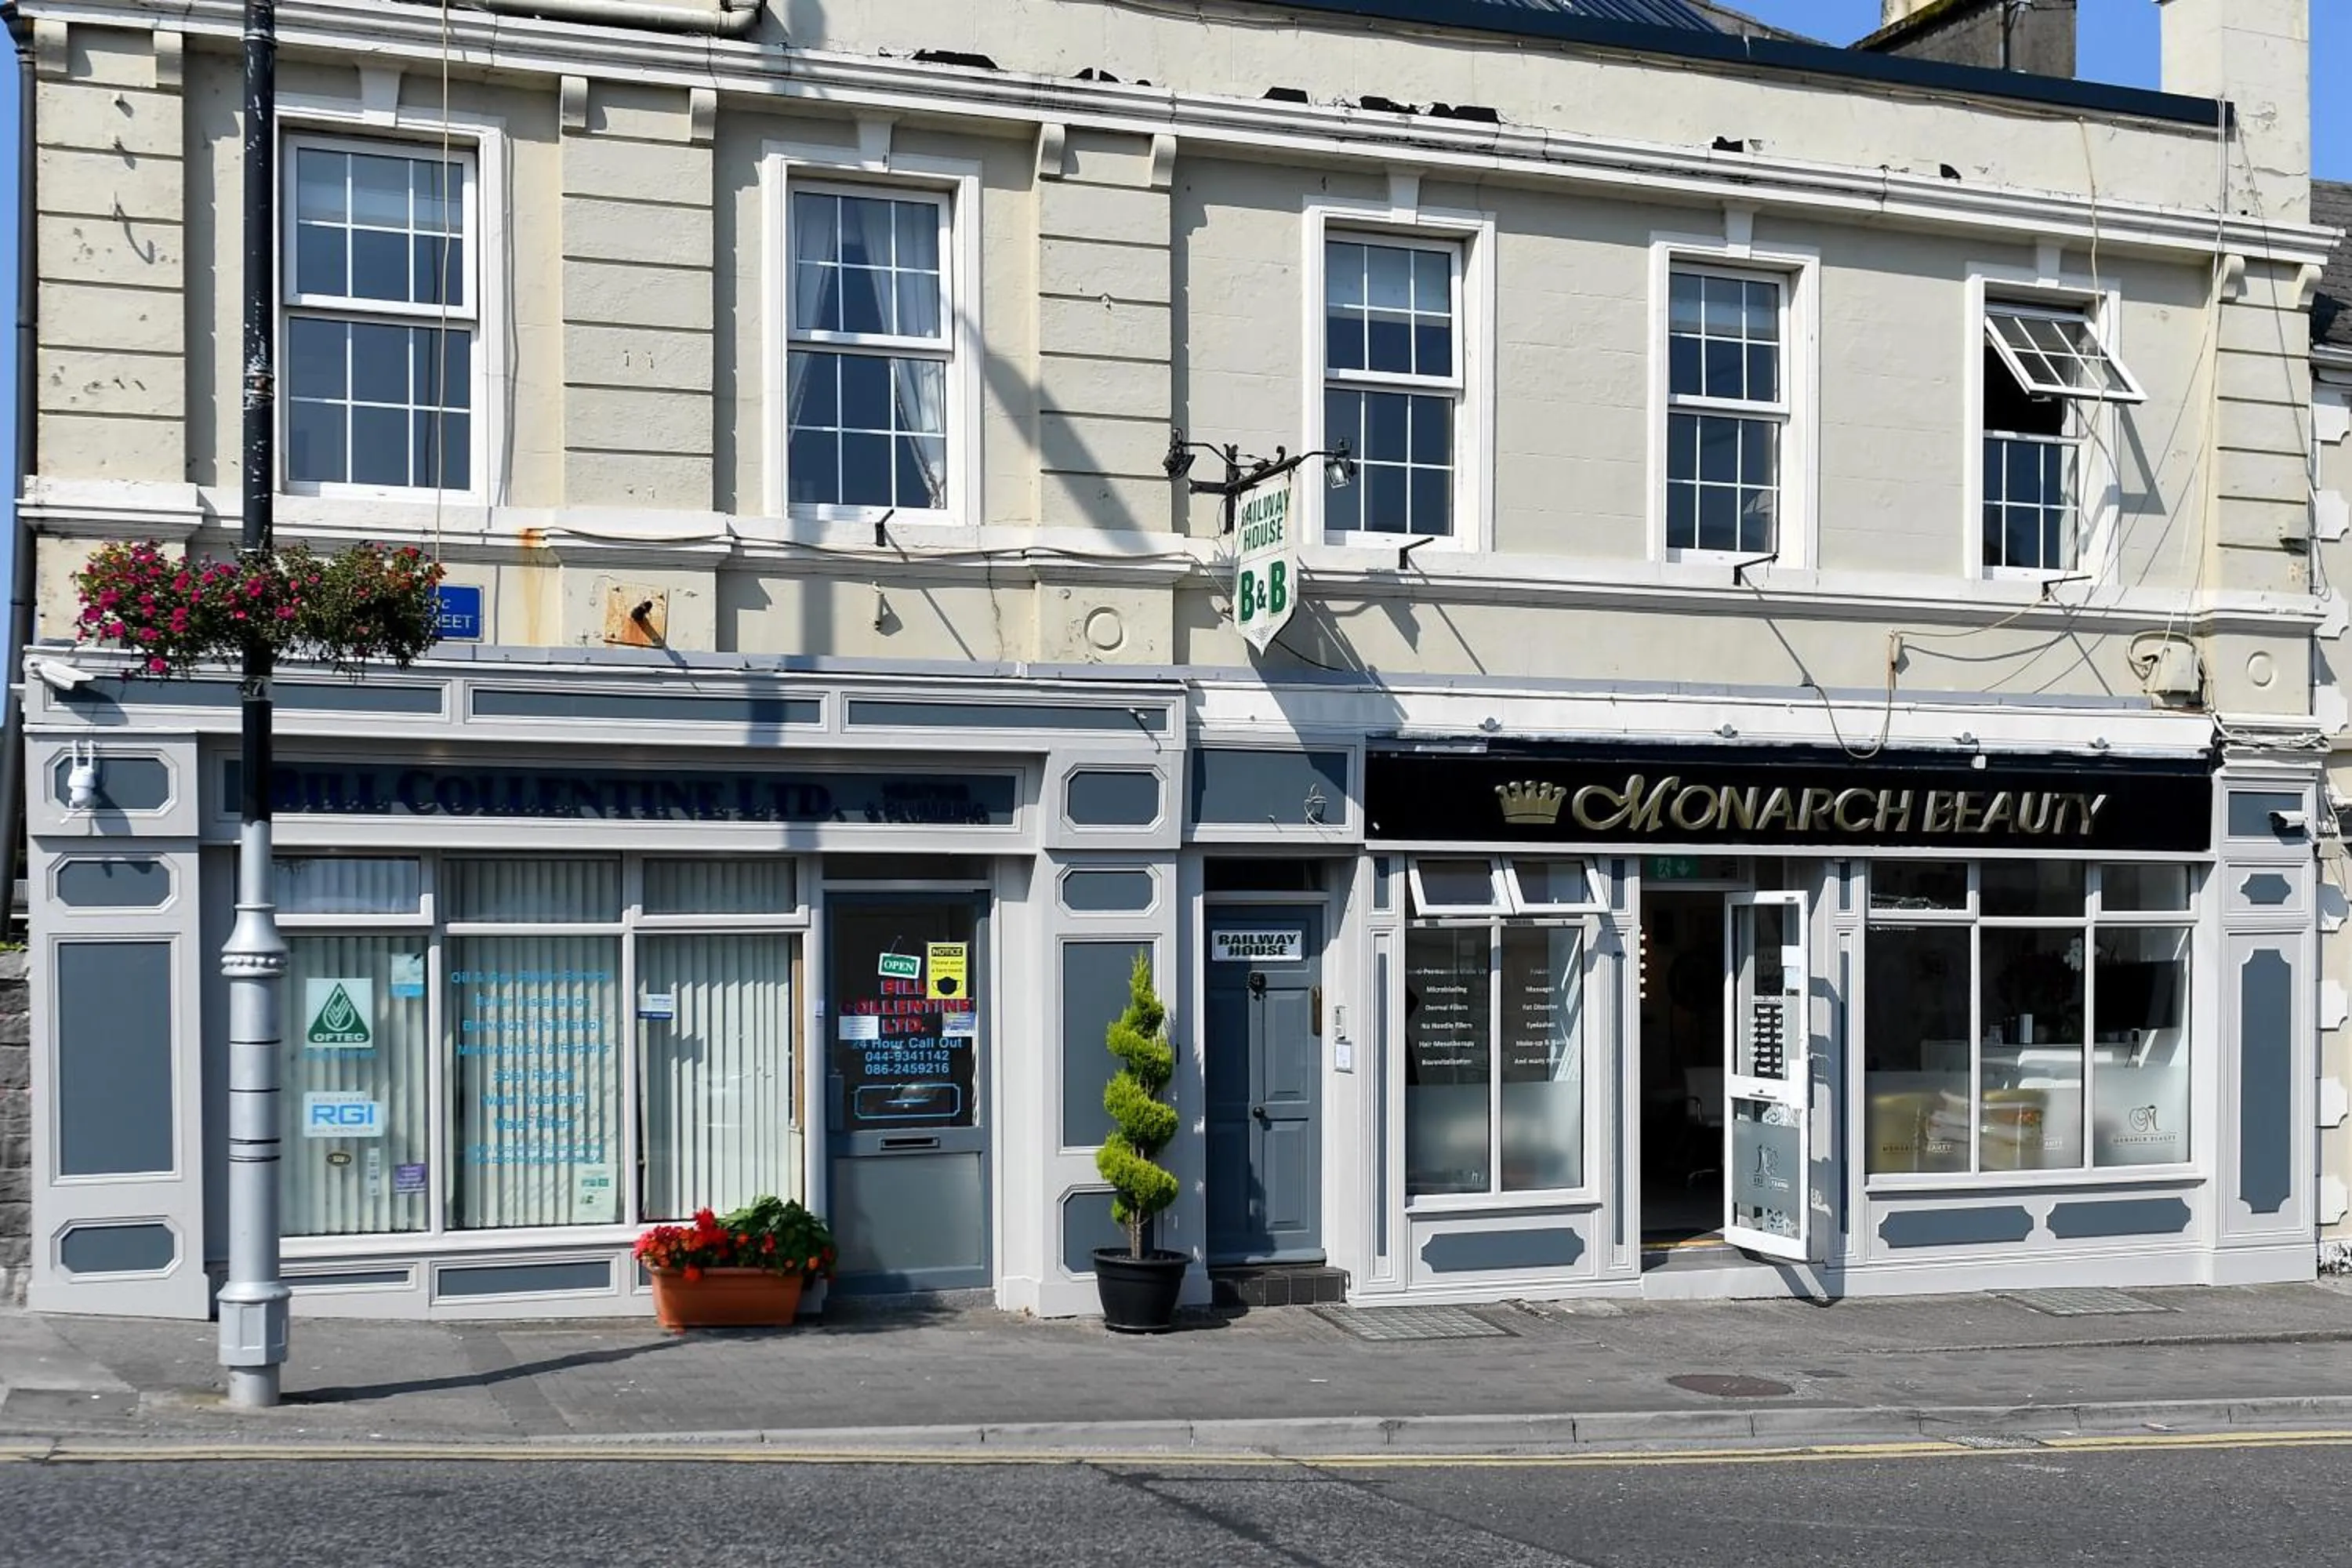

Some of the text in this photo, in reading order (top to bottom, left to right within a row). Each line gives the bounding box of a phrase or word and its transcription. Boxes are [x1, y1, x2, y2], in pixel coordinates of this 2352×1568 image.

[1243, 517, 1283, 551] HOUSE
[432, 614, 474, 629] REET
[1572, 775, 2107, 835] MONARCH BEAUTY
[1218, 934, 1297, 946] RAILWAY
[932, 947, 962, 956] NOTICE
[1228, 945, 1287, 956] HOUSE
[883, 960, 915, 972] OPEN
[880, 980, 926, 995] BILL
[839, 998, 972, 1014] COLLENTINE
[882, 1018, 926, 1034] LTD.
[314, 1033, 365, 1042] OFTEC
[872, 1038, 903, 1048] Hour
[908, 1037, 934, 1047] Call
[938, 1037, 963, 1048] Out
[865, 1051, 949, 1062] 044-9341142
[865, 1063, 949, 1075] 086-2459216
[311, 1105, 374, 1126] RGI
